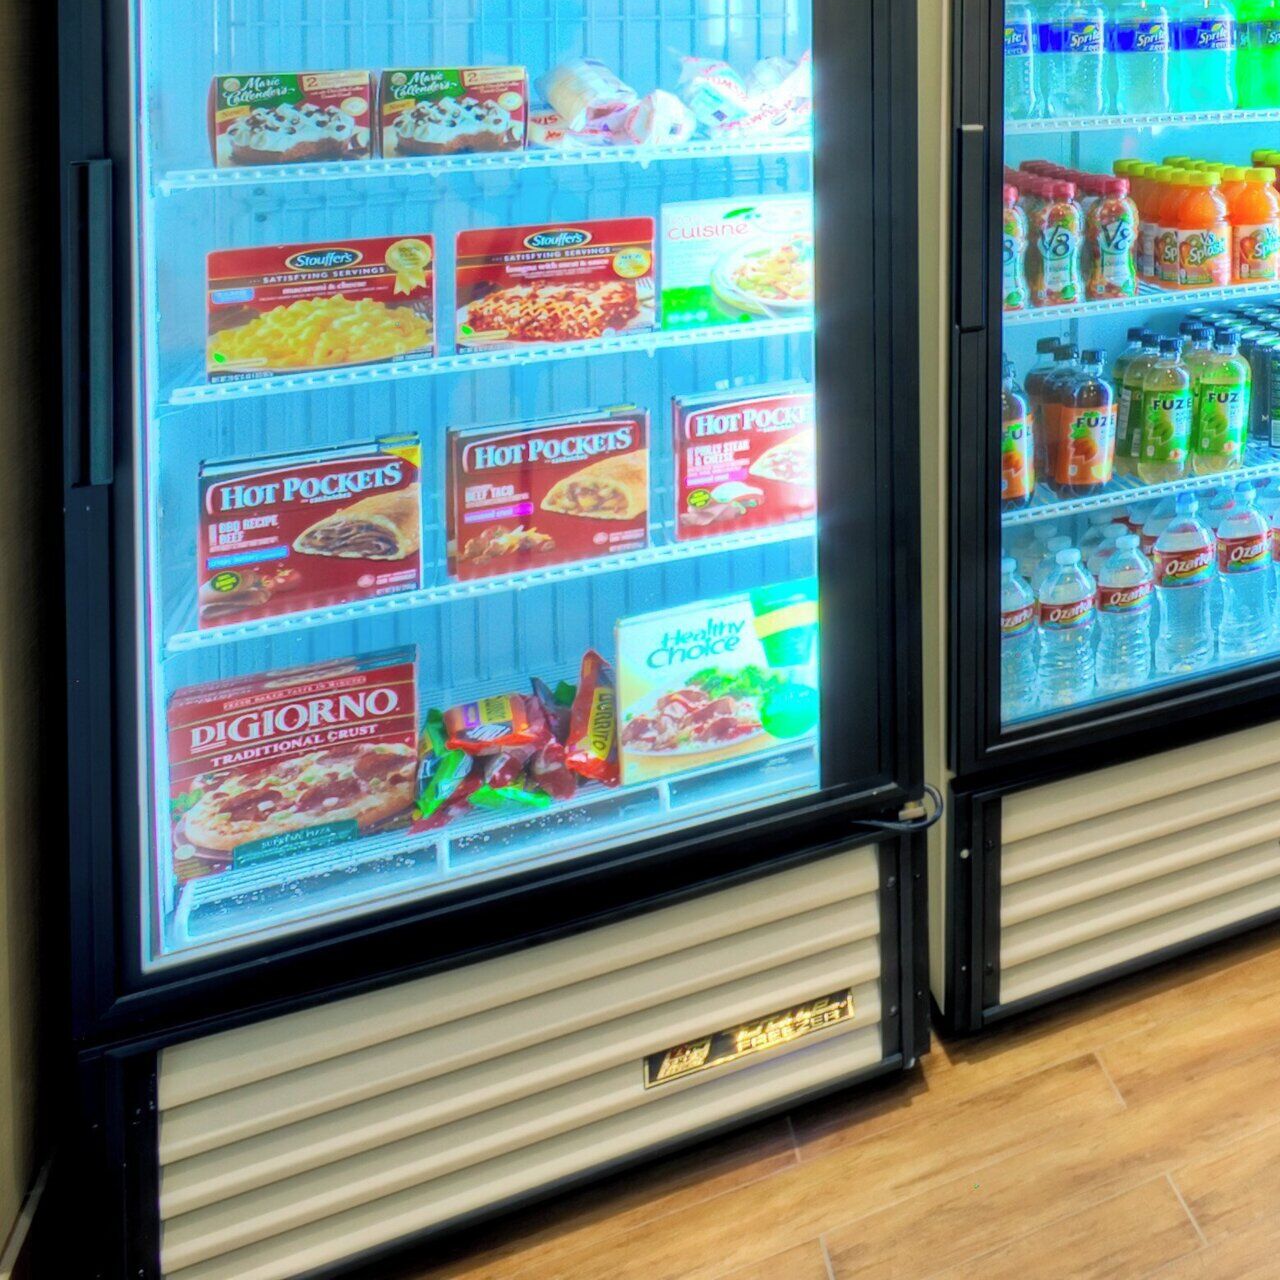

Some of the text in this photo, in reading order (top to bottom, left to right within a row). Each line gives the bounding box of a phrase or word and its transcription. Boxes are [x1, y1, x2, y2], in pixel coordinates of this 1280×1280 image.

[531, 232, 584, 248] Stouffer's
[668, 223, 750, 241] cuisine
[1040, 224, 1070, 257] V8
[1101, 219, 1130, 251] V8
[296, 251, 354, 268] Stouffer's
[504, 251, 562, 262] SATISFYING
[262, 266, 386, 285] SATISFYING SERVINGS
[1153, 396, 1193, 411] FUZE
[696, 413, 740, 437] HOT
[475, 427, 633, 470] HOT POCKETS
[220, 461, 404, 511] HOT POCKETS
[218, 519, 241, 535] BBQ
[661, 617, 746, 650] Healthy
[647, 633, 741, 671] Choice
[211, 723, 379, 769] TRADITIONAL CRUST
[306, 826, 332, 841] PIZZA
[736, 1009, 841, 1053] FREEZER
